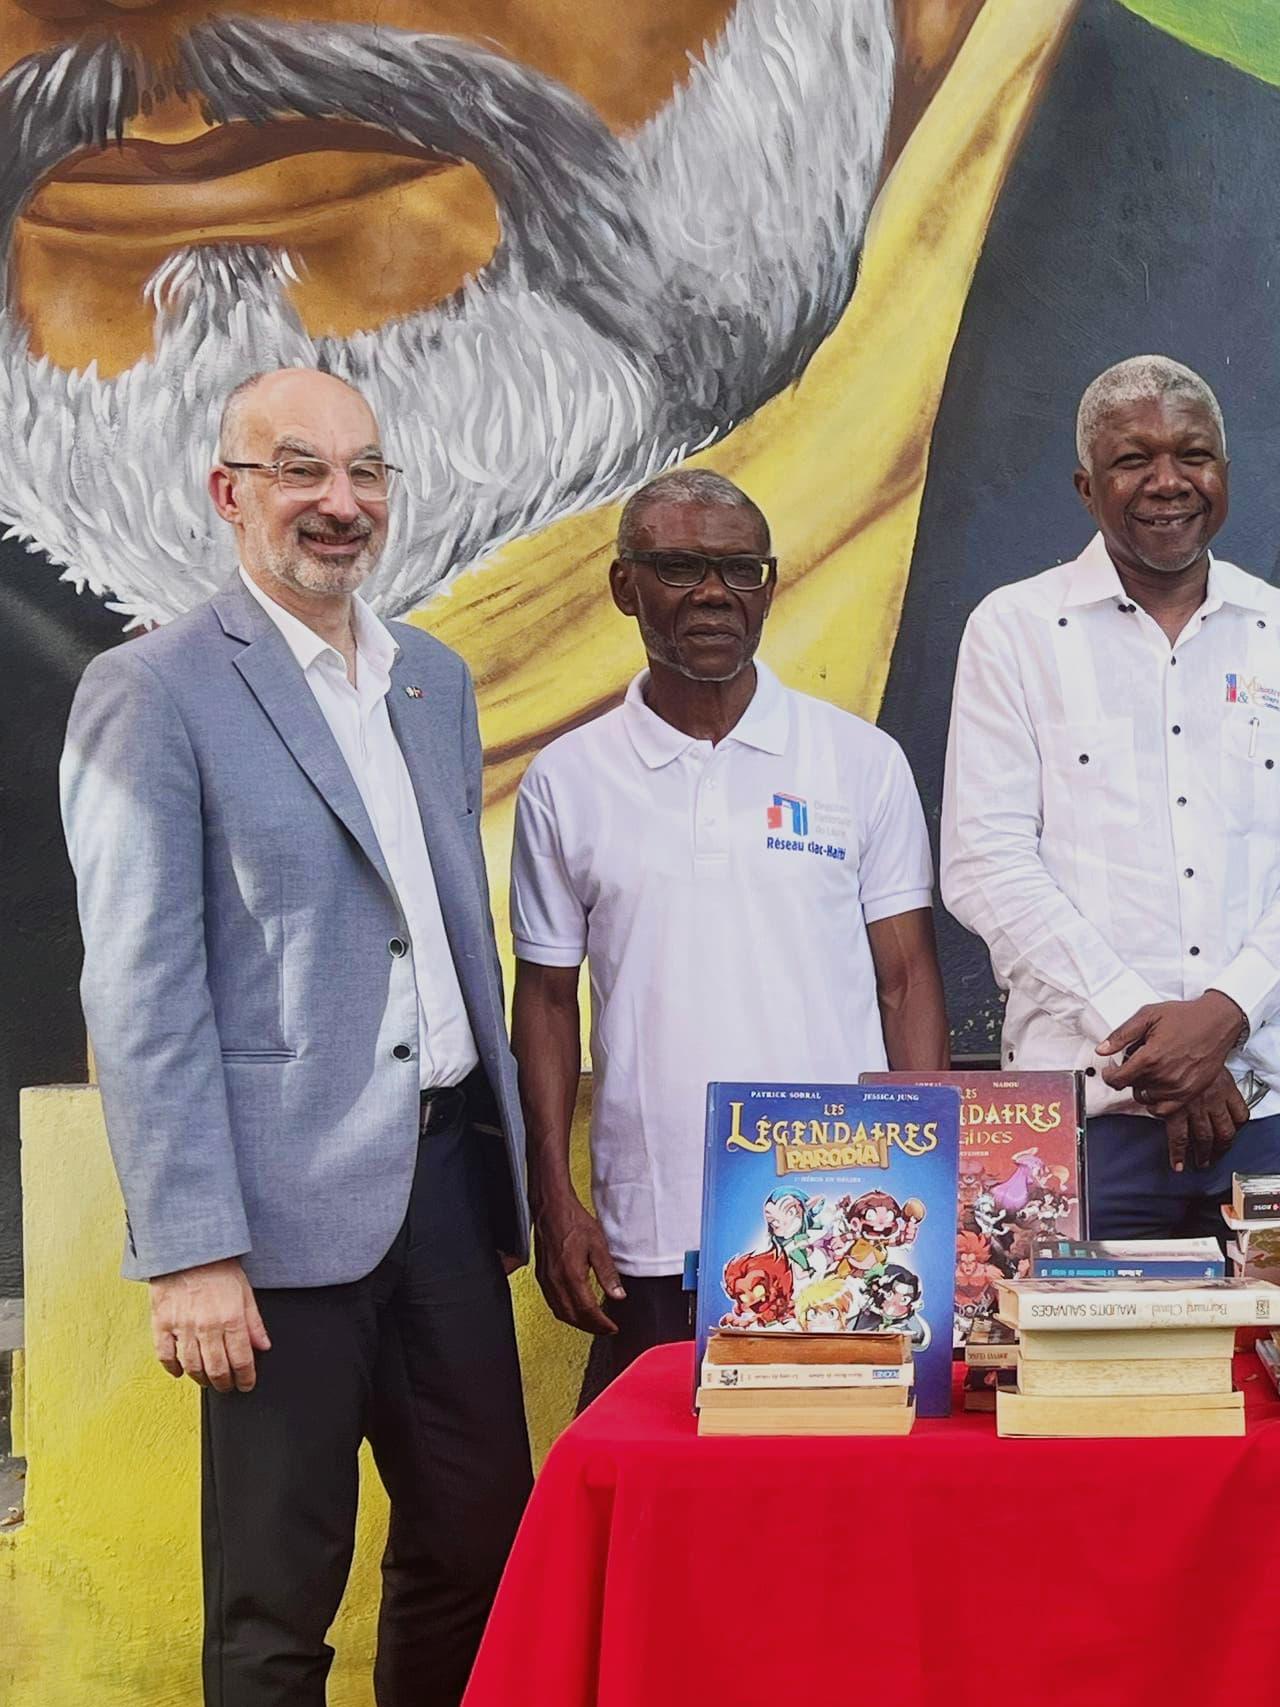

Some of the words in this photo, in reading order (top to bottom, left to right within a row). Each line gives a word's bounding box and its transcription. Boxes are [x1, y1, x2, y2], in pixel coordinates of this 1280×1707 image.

[766, 836, 804, 852] Réseau
[751, 1090, 787, 1099] PATRICK
[789, 1091, 821, 1099] SOBRAL
[862, 1092, 895, 1101] JESSICA
[896, 1092, 919, 1101] JUNG
[823, 1103, 845, 1116] LES
[725, 1101, 939, 1157] LÉGENDAIRES
[1031, 1303, 1087, 1318] SAUVAGES
[1088, 1303, 1137, 1317] MAUDITS
[1186, 1303, 1228, 1317] Bernard
